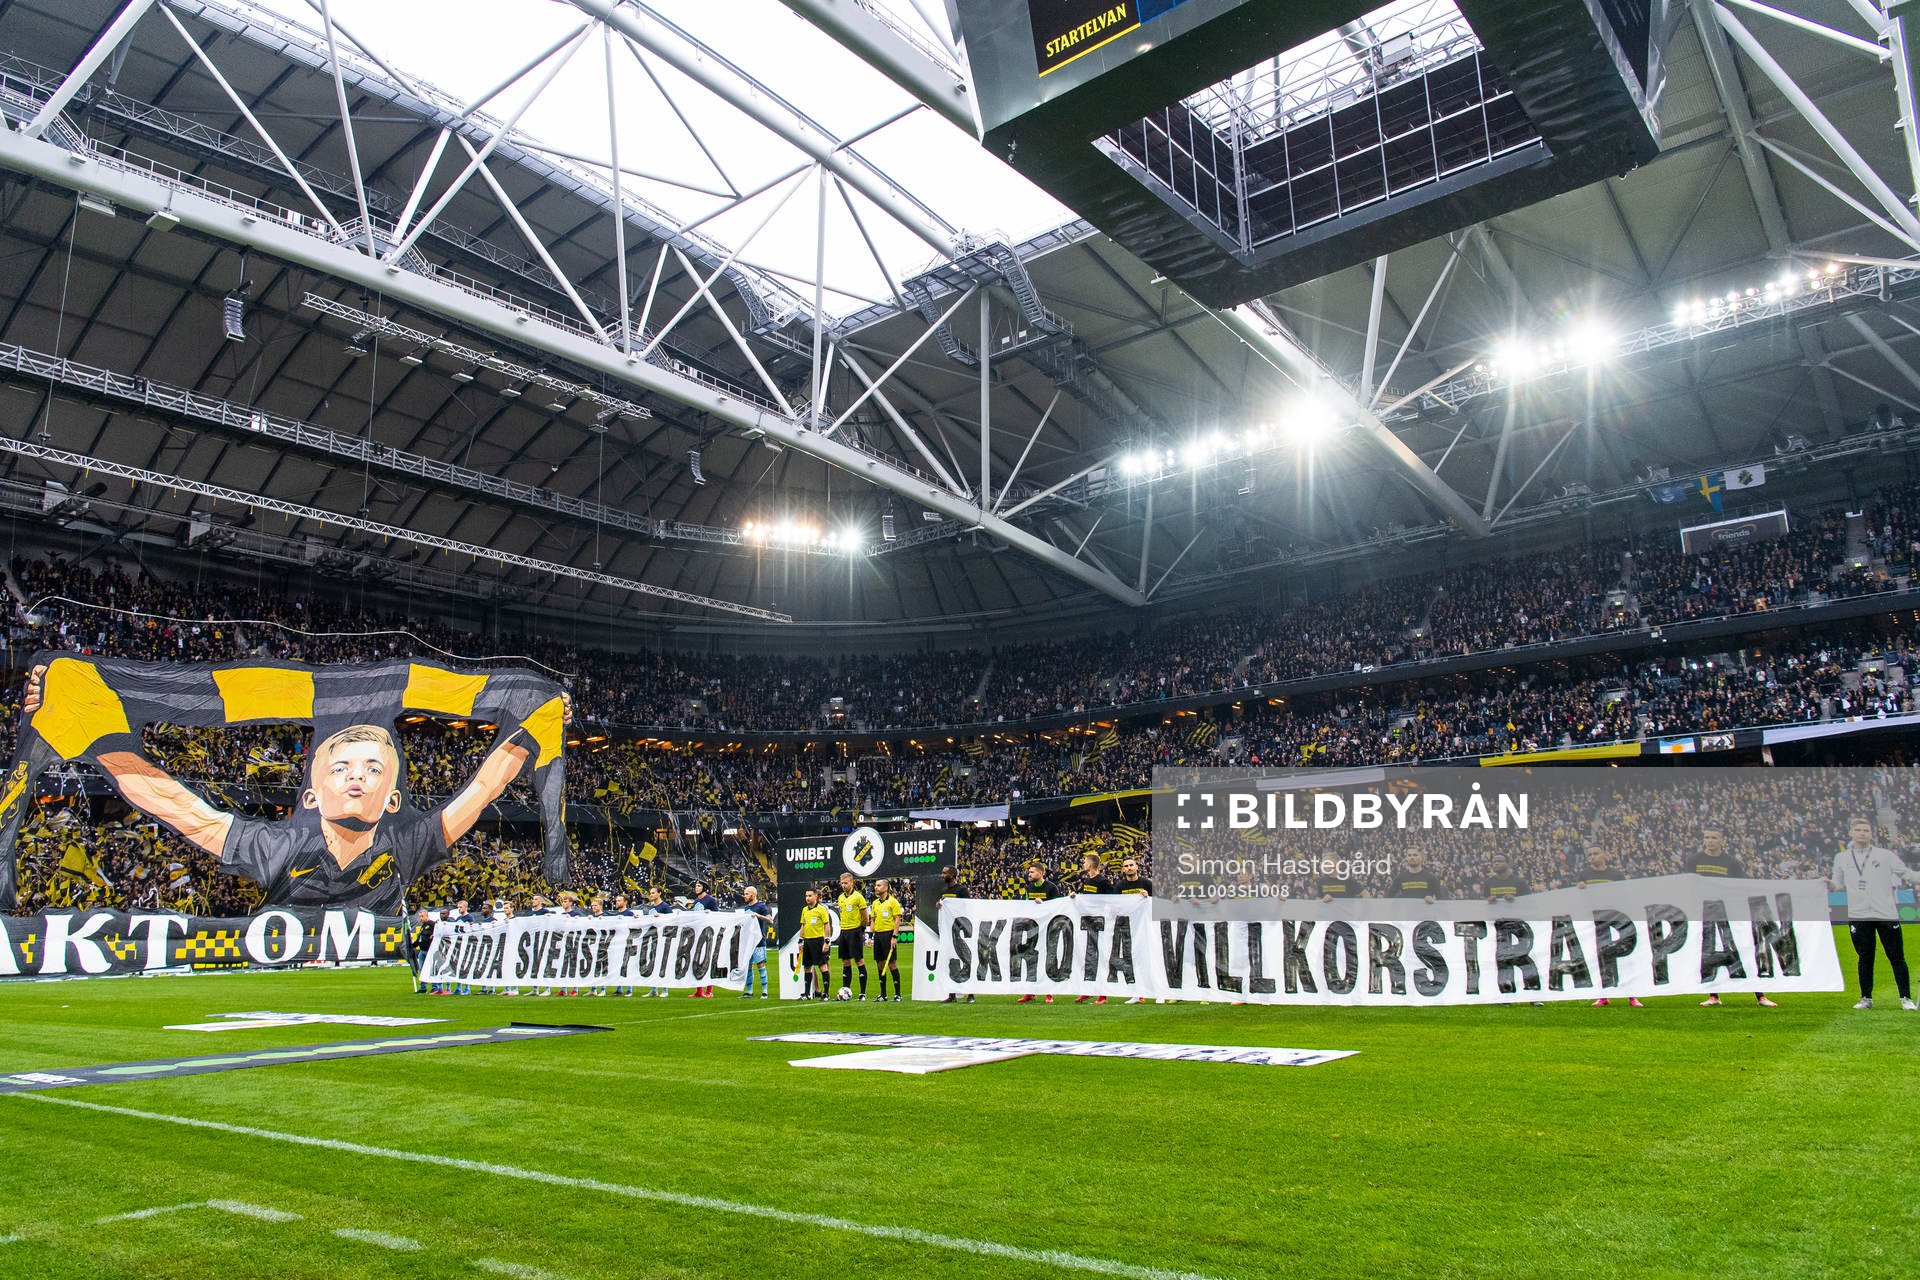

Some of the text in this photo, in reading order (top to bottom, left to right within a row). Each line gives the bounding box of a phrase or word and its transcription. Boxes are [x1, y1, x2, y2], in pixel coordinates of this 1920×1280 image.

[1046, 3, 1127, 58] STARTELVAN
[786, 847, 833, 862] UNIBET
[894, 840, 946, 855] UNIBET
[245, 910, 376, 964] OM
[430, 925, 507, 979] RÄDDA
[515, 928, 616, 979] SVENSK
[926, 951, 938, 971] U
[948, 893, 1801, 996] SKROTA VILLKORSTRAPPAN
